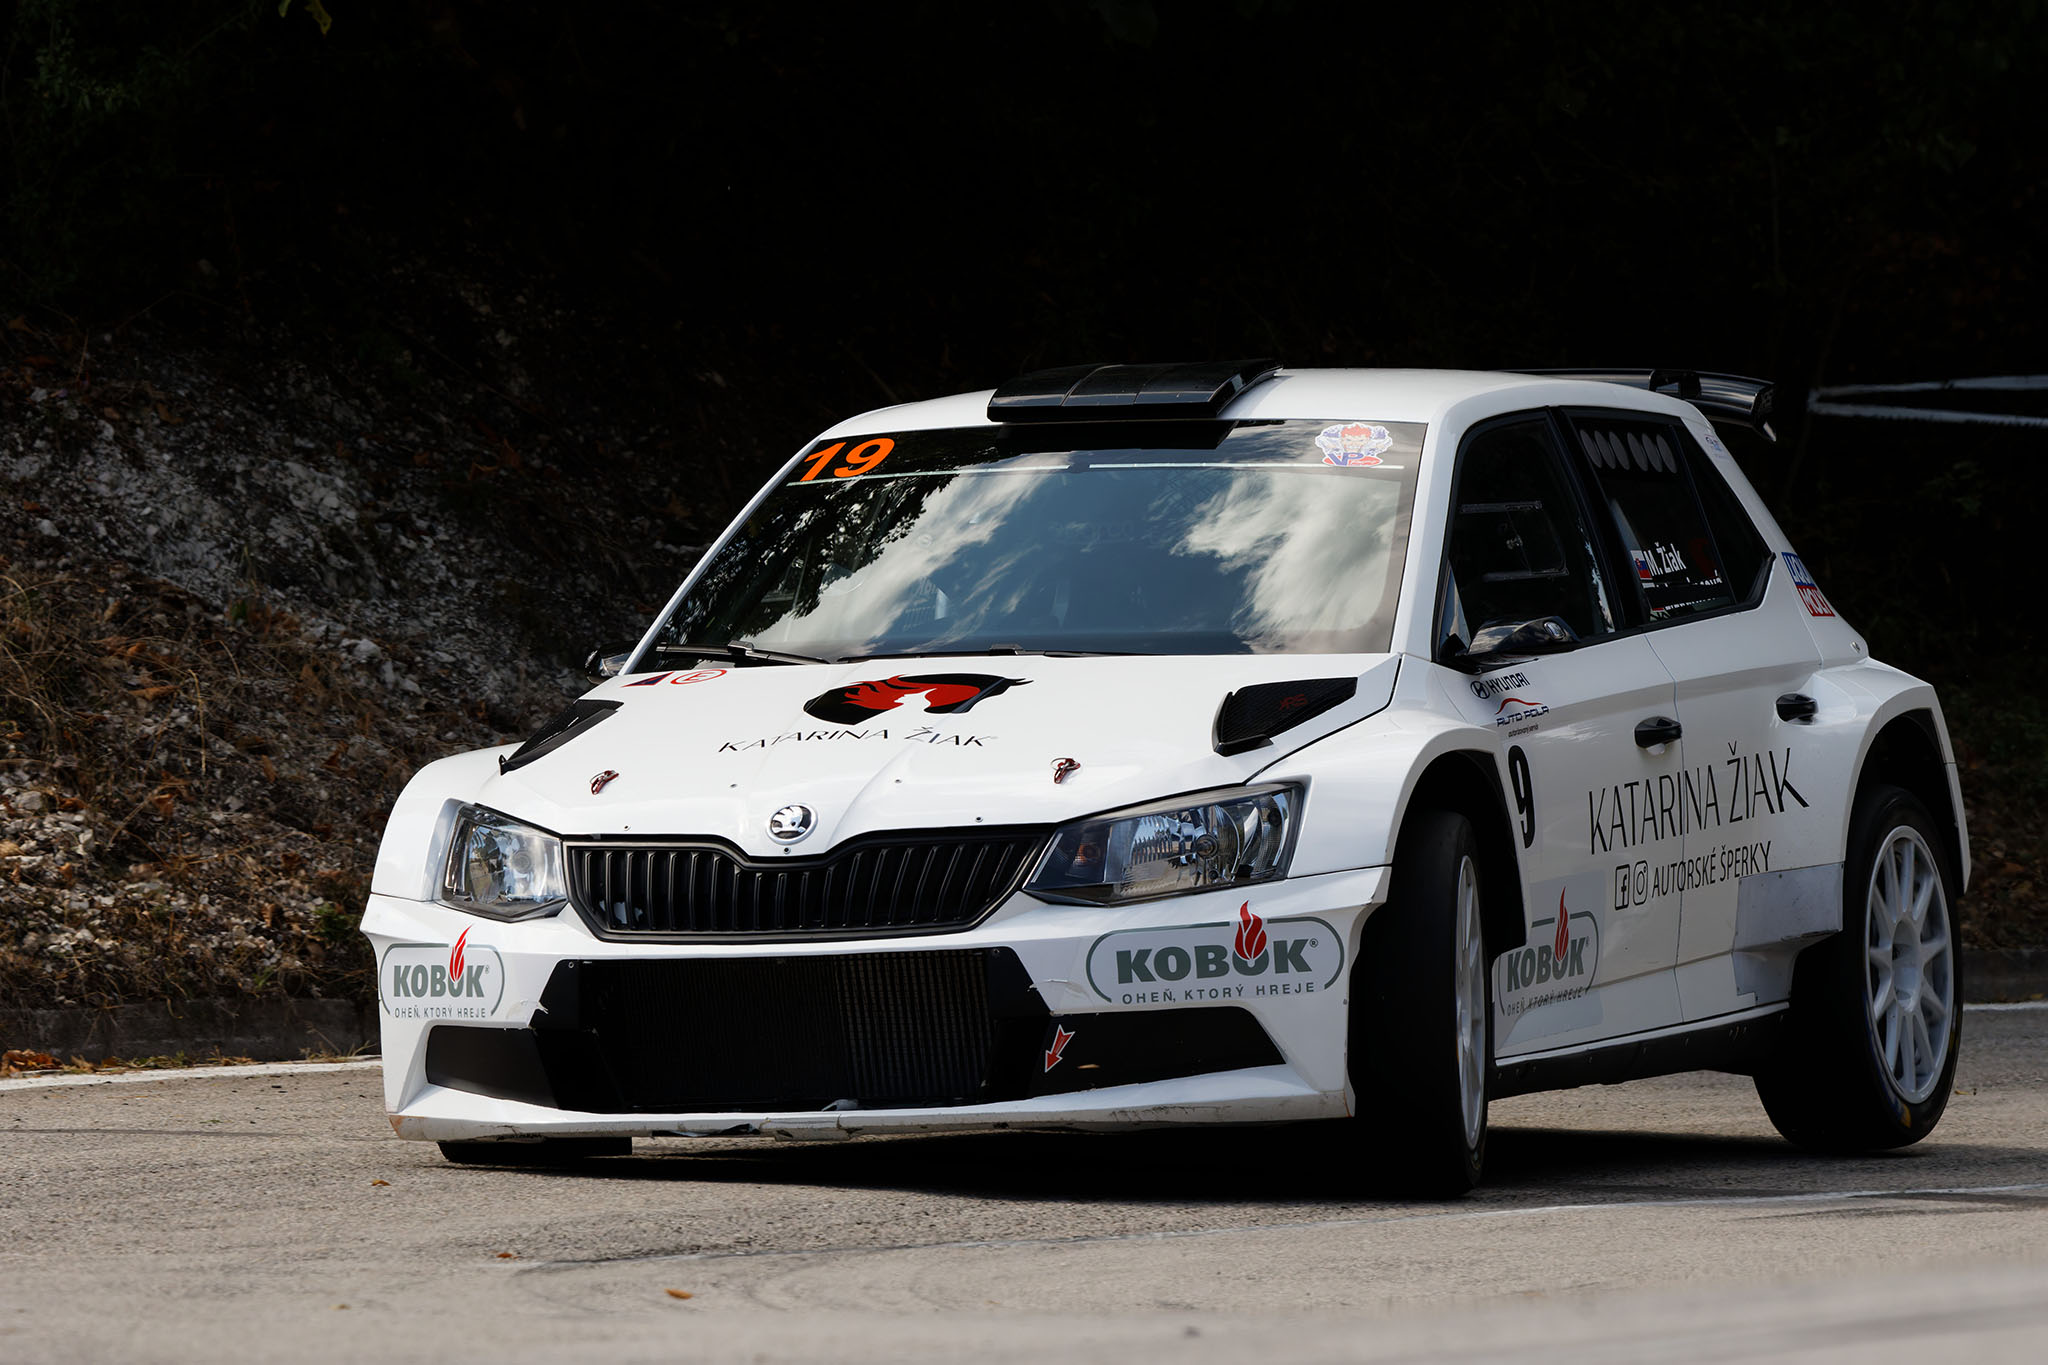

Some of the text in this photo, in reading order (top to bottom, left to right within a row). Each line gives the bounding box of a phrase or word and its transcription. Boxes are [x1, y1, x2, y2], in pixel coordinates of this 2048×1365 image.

[799, 437, 896, 482] 19
[1642, 541, 1688, 577] M. Žiak
[1487, 672, 1530, 694] HYUNDAI
[1496, 706, 1549, 727] AUTO POLA
[717, 726, 993, 753] KATARINA ŽIAK
[1507, 744, 1536, 849] 9
[1588, 740, 1810, 855] KATARINA ŽIAK
[1651, 840, 1772, 898] AUTORSKÉ ŠPERKY
[1121, 981, 1316, 1005] OHEŇ, KTORÝ HREJE
[424, 1004, 453, 1018] KTORÝ
[457, 1007, 487, 1018] HREJE
